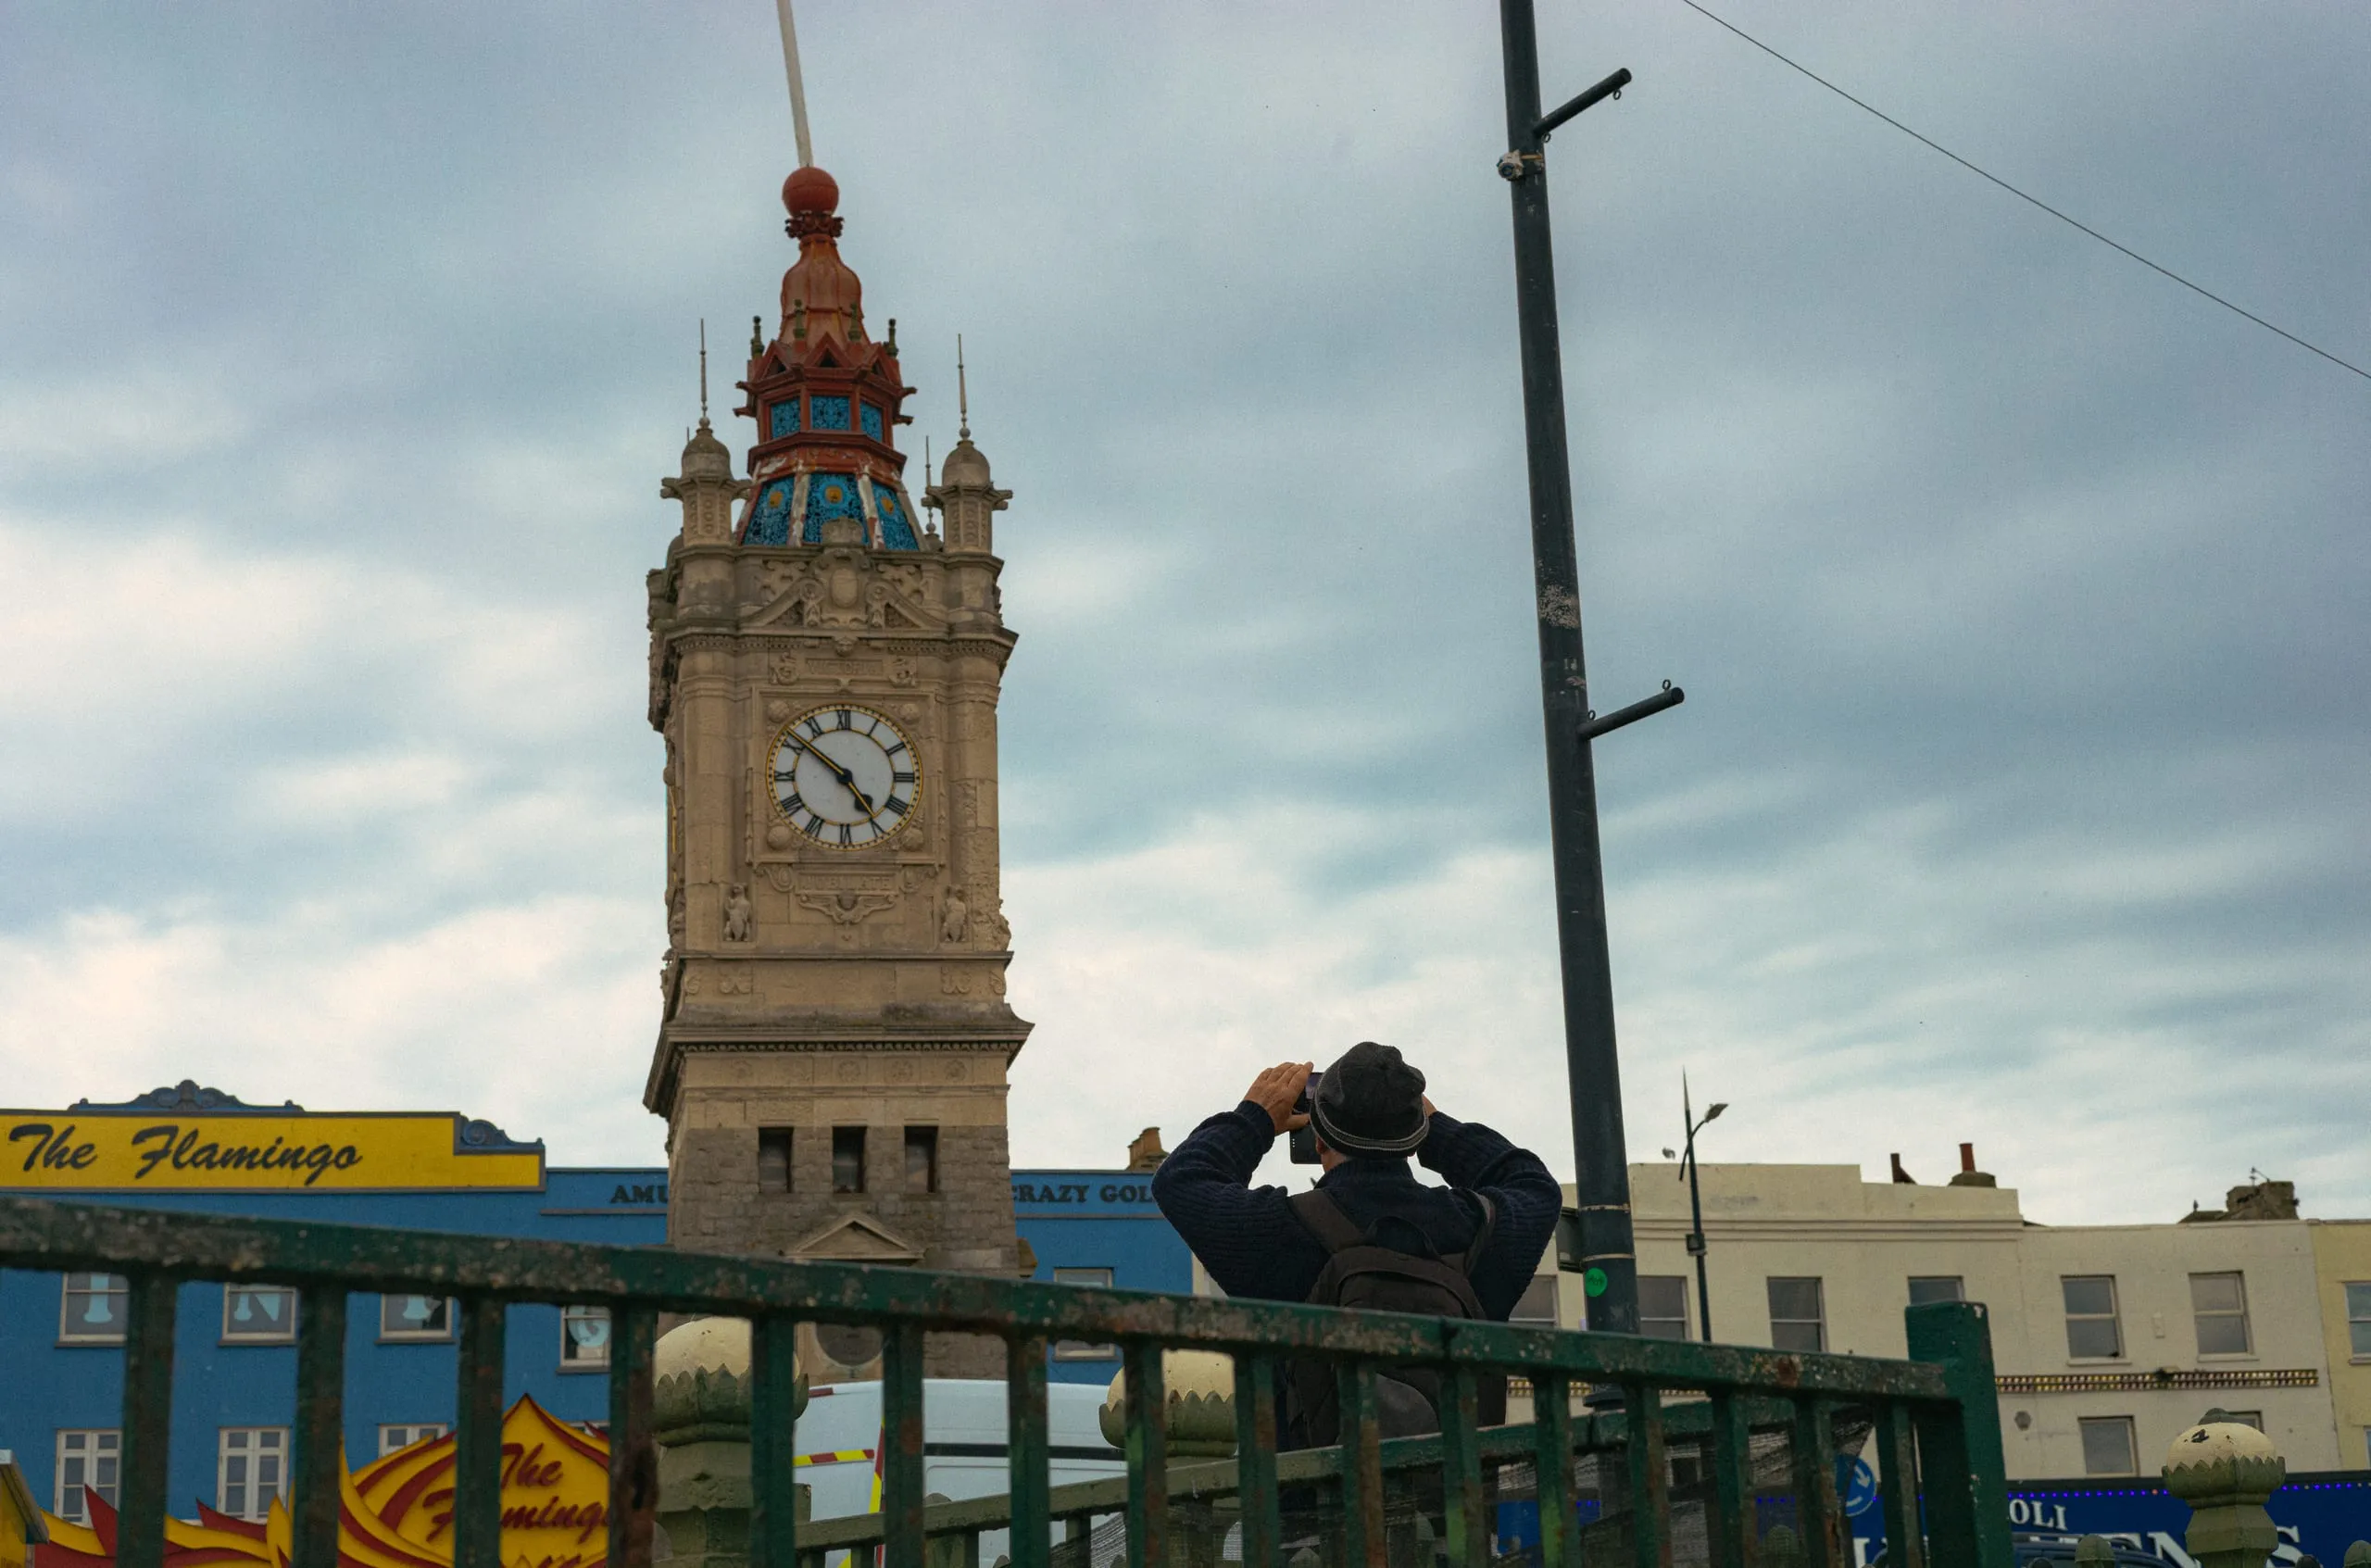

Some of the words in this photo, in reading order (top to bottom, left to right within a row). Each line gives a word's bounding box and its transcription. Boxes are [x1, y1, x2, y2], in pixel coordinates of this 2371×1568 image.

[805, 716, 823, 737] XI
[836, 709, 851, 731] XII
[893, 772, 915, 783] III
[9, 1123, 96, 1172] The
[132, 1124, 362, 1186] Flamingo
[502, 1442, 563, 1488] The
[422, 1486, 609, 1546] Fming
